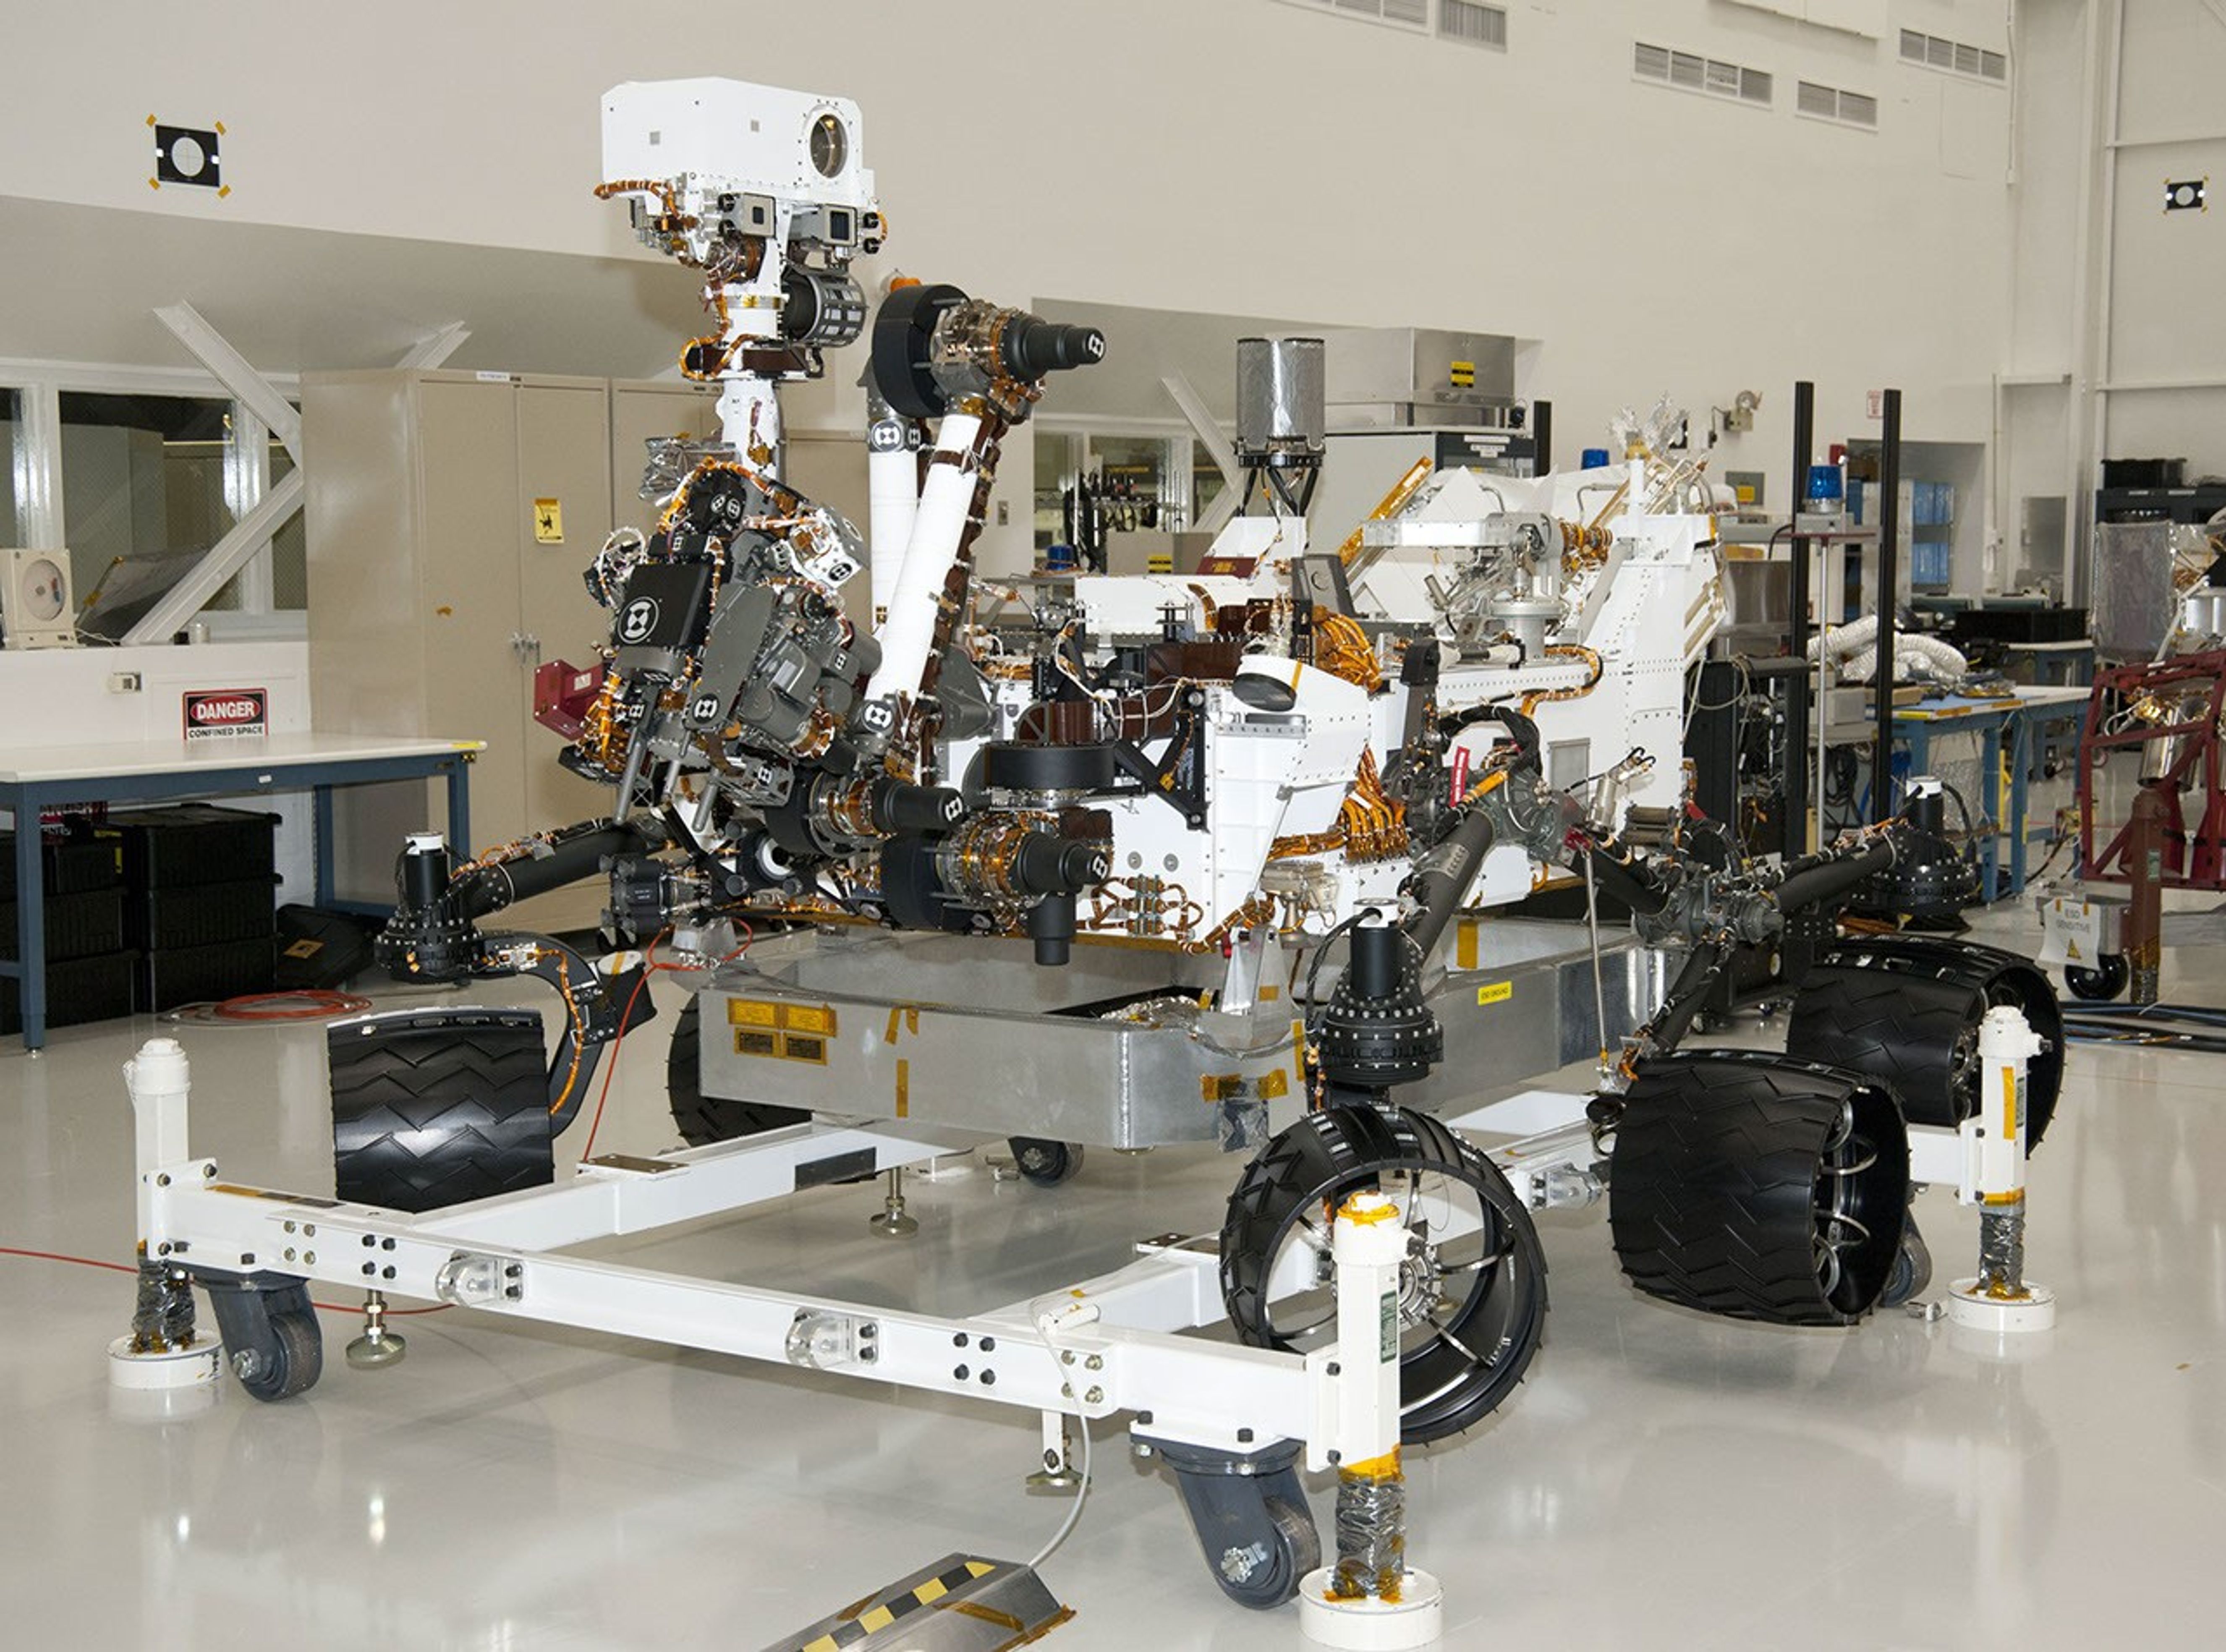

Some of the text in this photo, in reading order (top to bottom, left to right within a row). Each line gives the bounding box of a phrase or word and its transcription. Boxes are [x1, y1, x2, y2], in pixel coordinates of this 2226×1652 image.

[196, 701, 255, 719] DANGER
[189, 726, 263, 738] CONFINED SPACE
